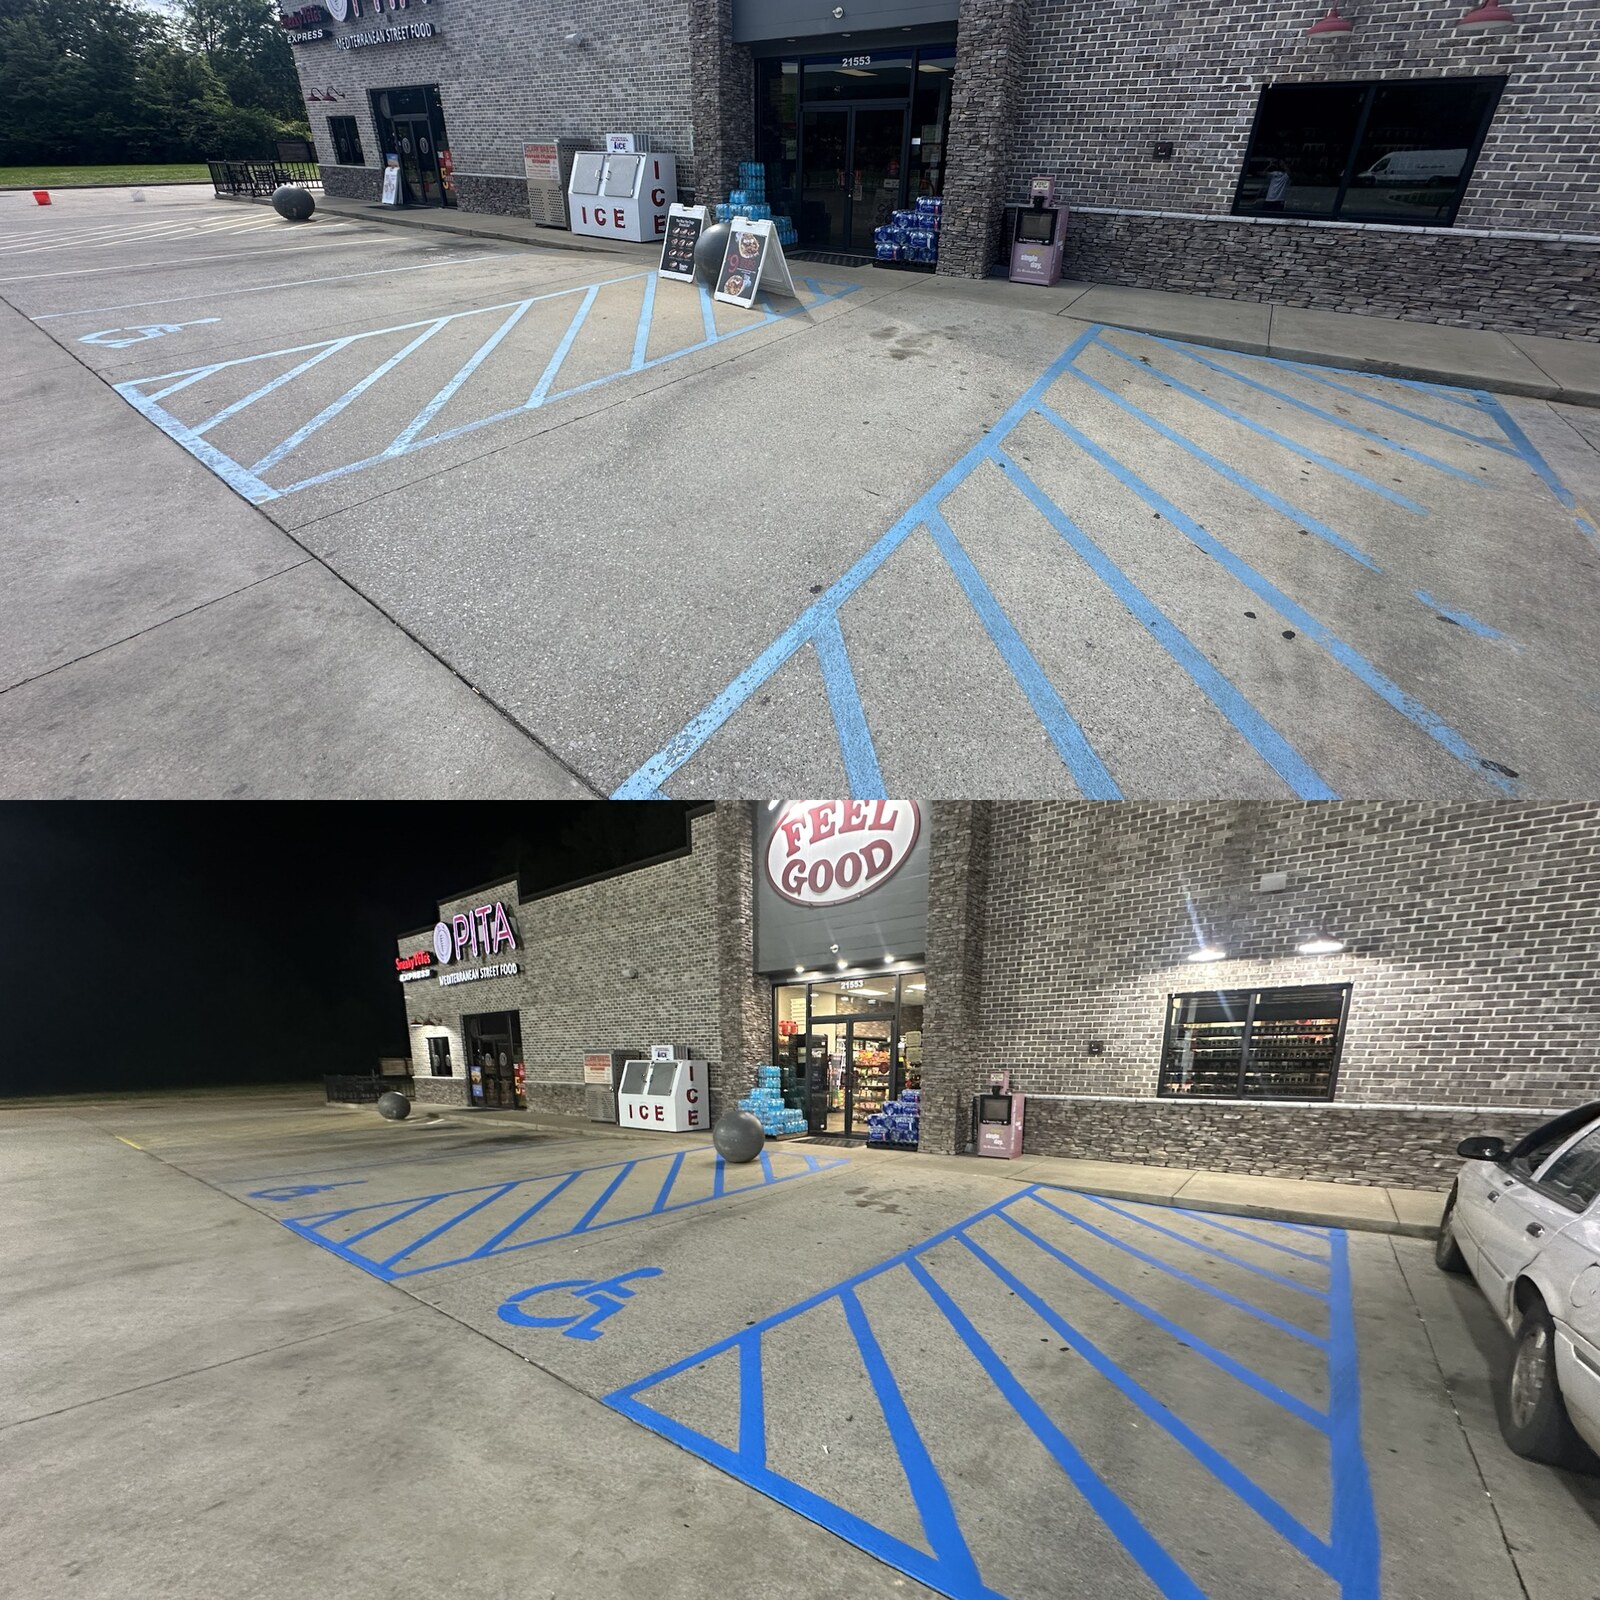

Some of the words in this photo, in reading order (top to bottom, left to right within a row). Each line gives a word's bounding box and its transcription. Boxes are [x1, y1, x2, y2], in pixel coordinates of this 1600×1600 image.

[287, 28, 323, 44] EXPRESS
[336, 30, 385, 50] MEDITERRANEAN
[385, 26, 410, 43] STREET
[410, 22, 432, 37] FOOD
[841, 55, 871, 67] 21553
[650, 159, 666, 235] ICE
[581, 206, 626, 229] ICE
[781, 800, 899, 858] FEEL
[781, 838, 894, 896] GOOD
[452, 901, 516, 961] PITA
[399, 969, 430, 982] EXPRESS
[438, 968, 480, 987] MEDITERRANEAN
[480, 965, 499, 979] STREET
[499, 962, 518, 976] FOOD
[840, 980, 863, 990] 21553
[686, 1065, 700, 1126] ICE
[628, 1104, 665, 1122] ICE
